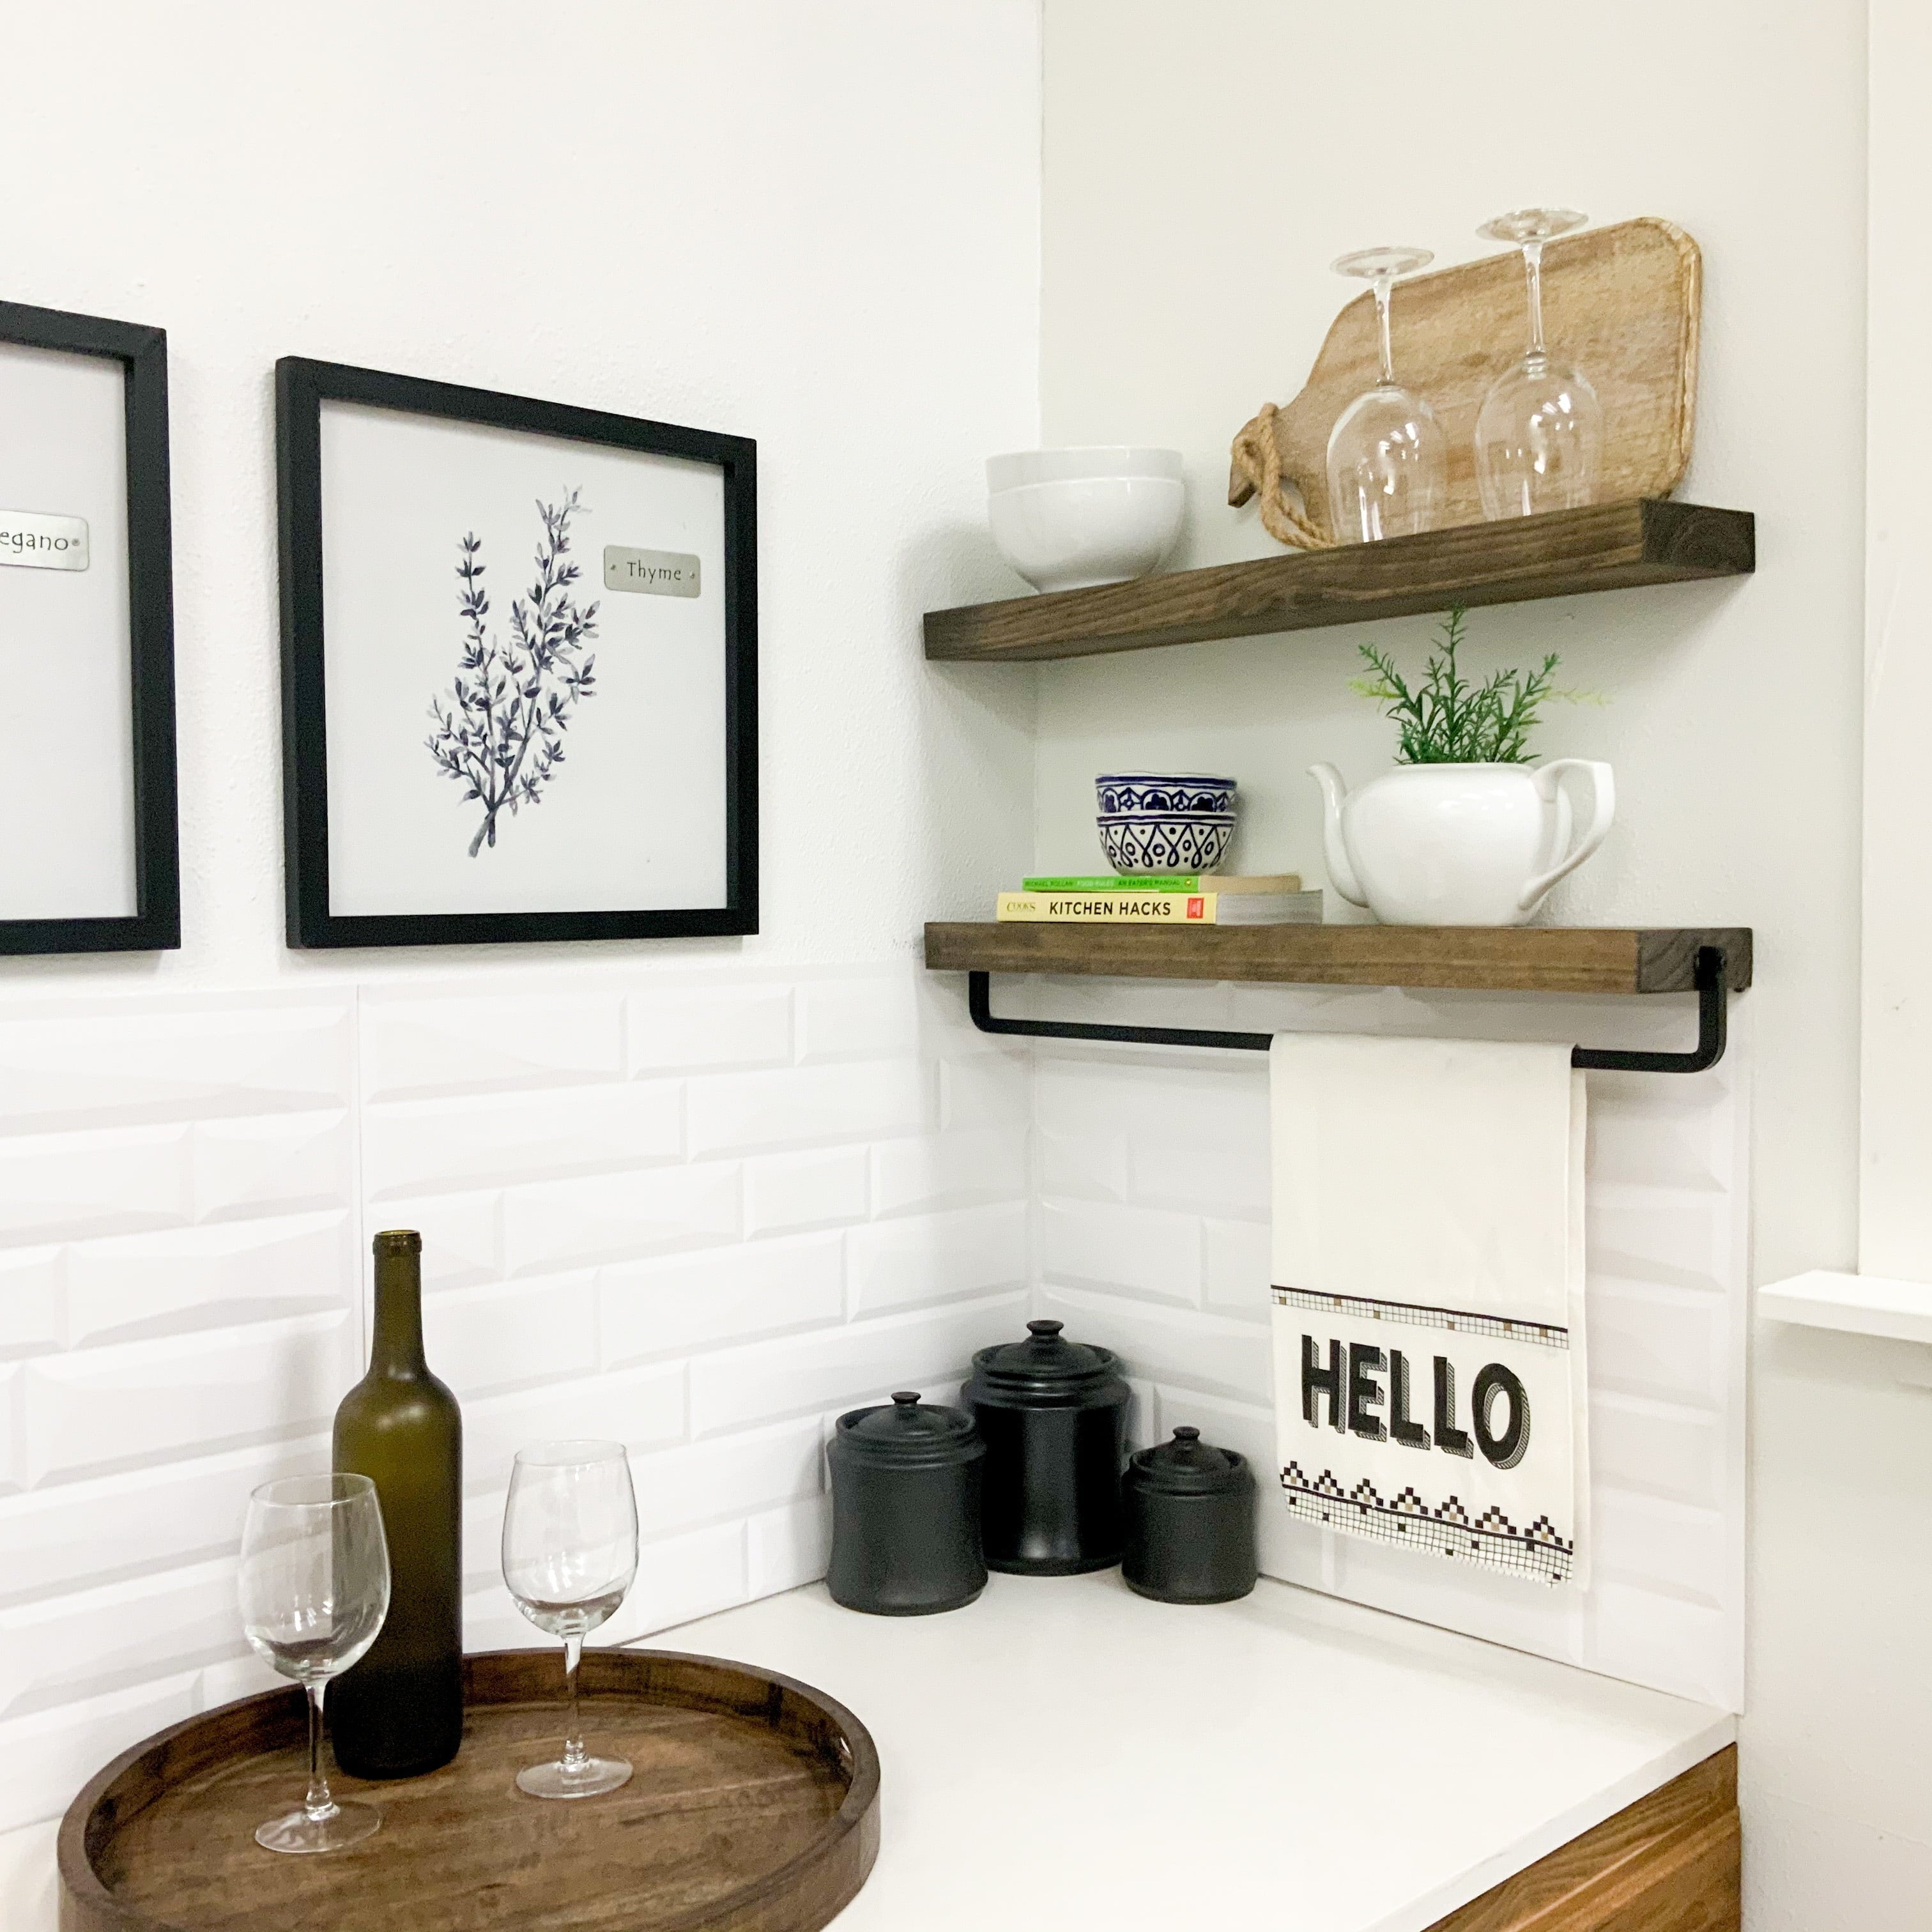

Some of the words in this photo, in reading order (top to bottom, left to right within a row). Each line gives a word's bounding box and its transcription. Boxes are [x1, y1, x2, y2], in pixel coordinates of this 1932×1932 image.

[627, 560, 681, 584] Thyme
[1050, 901, 1113, 915] KITCHEN
[1119, 902, 1171, 915] HACKS
[1301, 1334, 1531, 1470] HELLO
